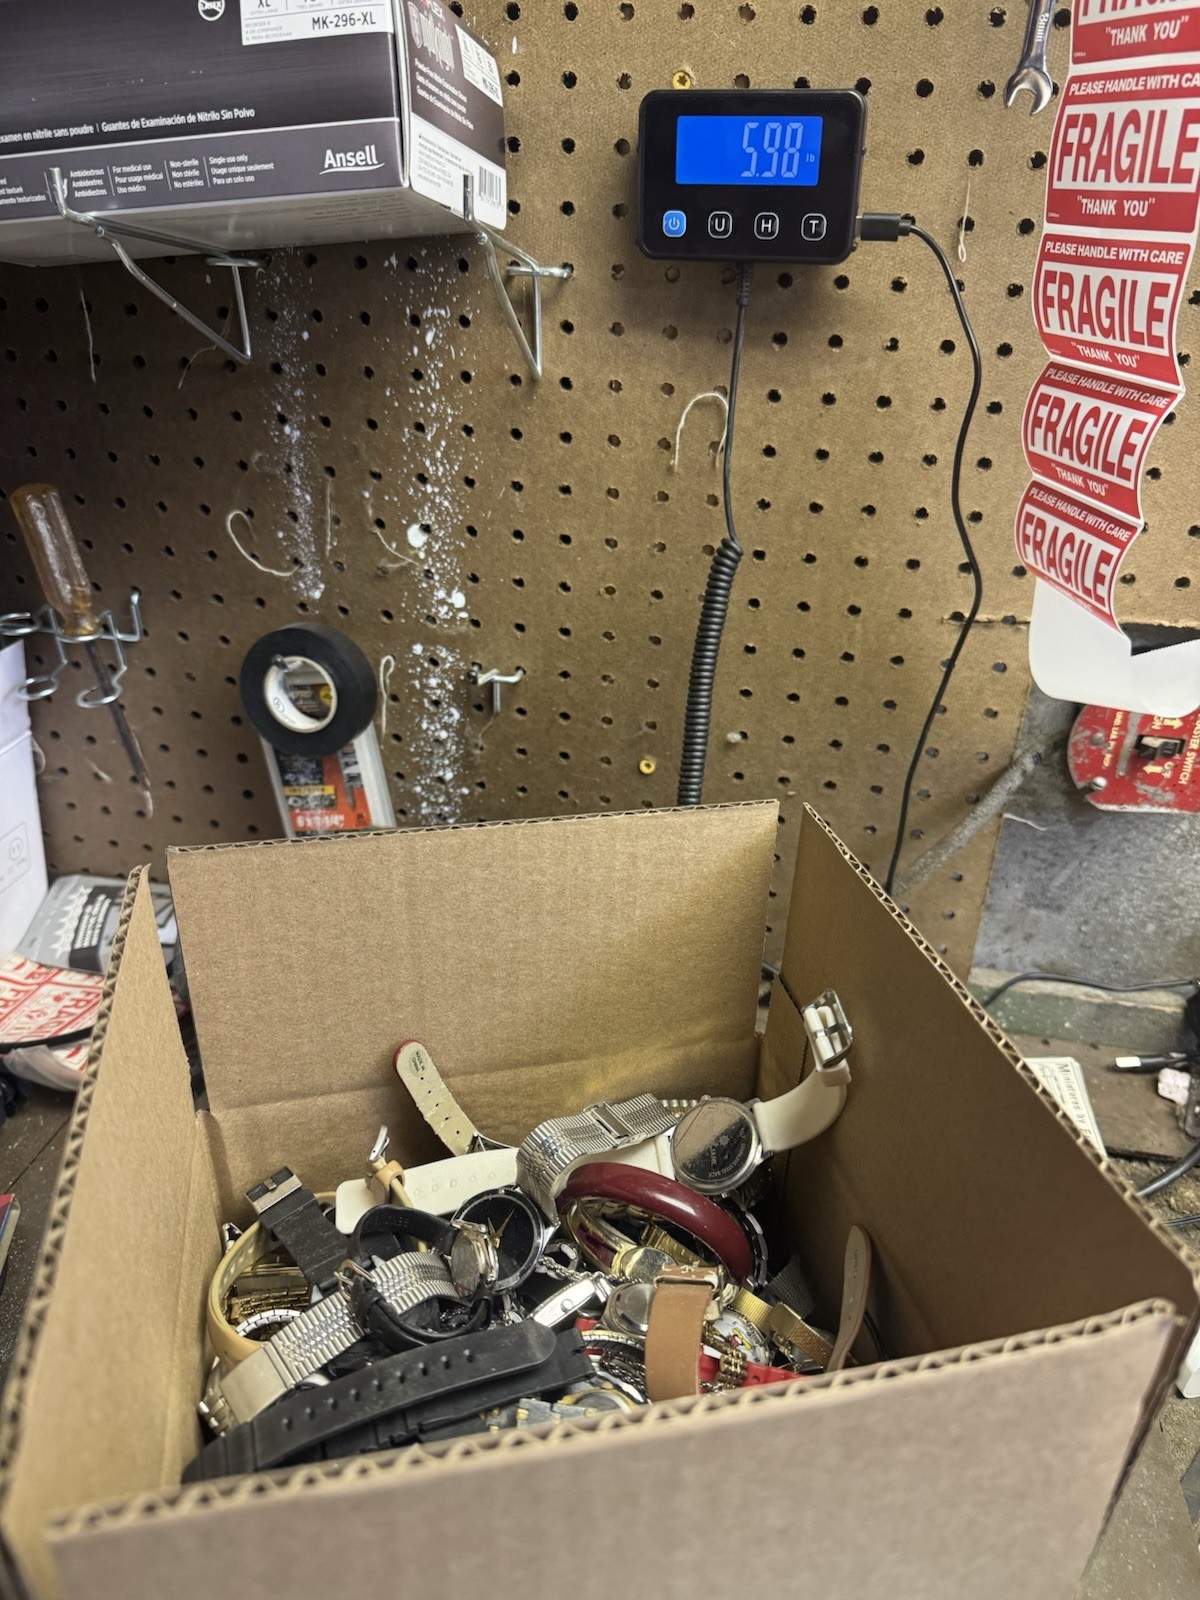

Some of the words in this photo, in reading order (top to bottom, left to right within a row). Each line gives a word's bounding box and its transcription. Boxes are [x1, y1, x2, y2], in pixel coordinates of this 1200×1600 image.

[312, 12, 376, 30] MK-296-XL
[1068, 80, 1106, 96] PLEASE
[1104, 76, 1146, 94] HANDLE
[1146, 74, 1180, 90] WITH
[24, 132, 32, 141] en
[33, 128, 52, 140] nitrile
[53, 128, 69, 137] sans
[70, 124, 94, 137] poudre
[102, 122, 130, 132] Guantes
[131, 119, 140, 129] de
[141, 114, 186, 128] Examinación
[187, 113, 197, 124] de
[198, 110, 220, 122] Nitrilo
[222, 109, 234, 120] Sin
[234, 107, 255, 118] Polvo
[324, 144, 378, 169] Ansell
[740, 121, 804, 178] 5.98
[805, 152, 816, 163] lb
[1056, 108, 1200, 184] FRAGILE
[112, 166, 121, 174] For
[122, 164, 142, 172] medical
[170, 158, 199, 168] Non-sterile
[209, 156, 226, 165] Single
[236, 154, 248, 162] only
[210, 167, 228, 176] Usage
[228, 165, 246, 174] unique
[246, 162, 274, 172] seulement
[70, 168, 104, 178] Ambidextrous
[114, 176, 127, 184] Pour
[128, 176, 142, 184] usage
[143, 172, 164, 181] médical
[172, 170, 182, 178] Non
[212, 177, 225, 185] Para
[117, 186, 127, 194] Uso
[128, 184, 146, 192] médico
[1044, 241, 1077, 256] PLEASE
[1078, 244, 1118, 260] HANDLE
[1118, 248, 1149, 262] WITH
[1150, 250, 1184, 265] CARE
[1042, 269, 1171, 349] FRAGILE
[1046, 368, 1079, 384] PLEASE
[1078, 377, 1115, 395] HANDLE
[1115, 385, 1141, 402] WITH
[1139, 392, 1170, 409] CARE
[1030, 392, 1148, 482] FRAGILE
[1028, 487, 1057, 508] PLEASE
[1056, 498, 1086, 522] HANDLE
[1084, 513, 1108, 532] WITH
[1106, 524, 1132, 543] CARE
[1020, 510, 1114, 608] FRAGILE
[1178, 751, 1196, 785] SWITCH
[1057, 1063, 1080, 1110] Miniatures
[1076, 1114, 1086, 1126] by
